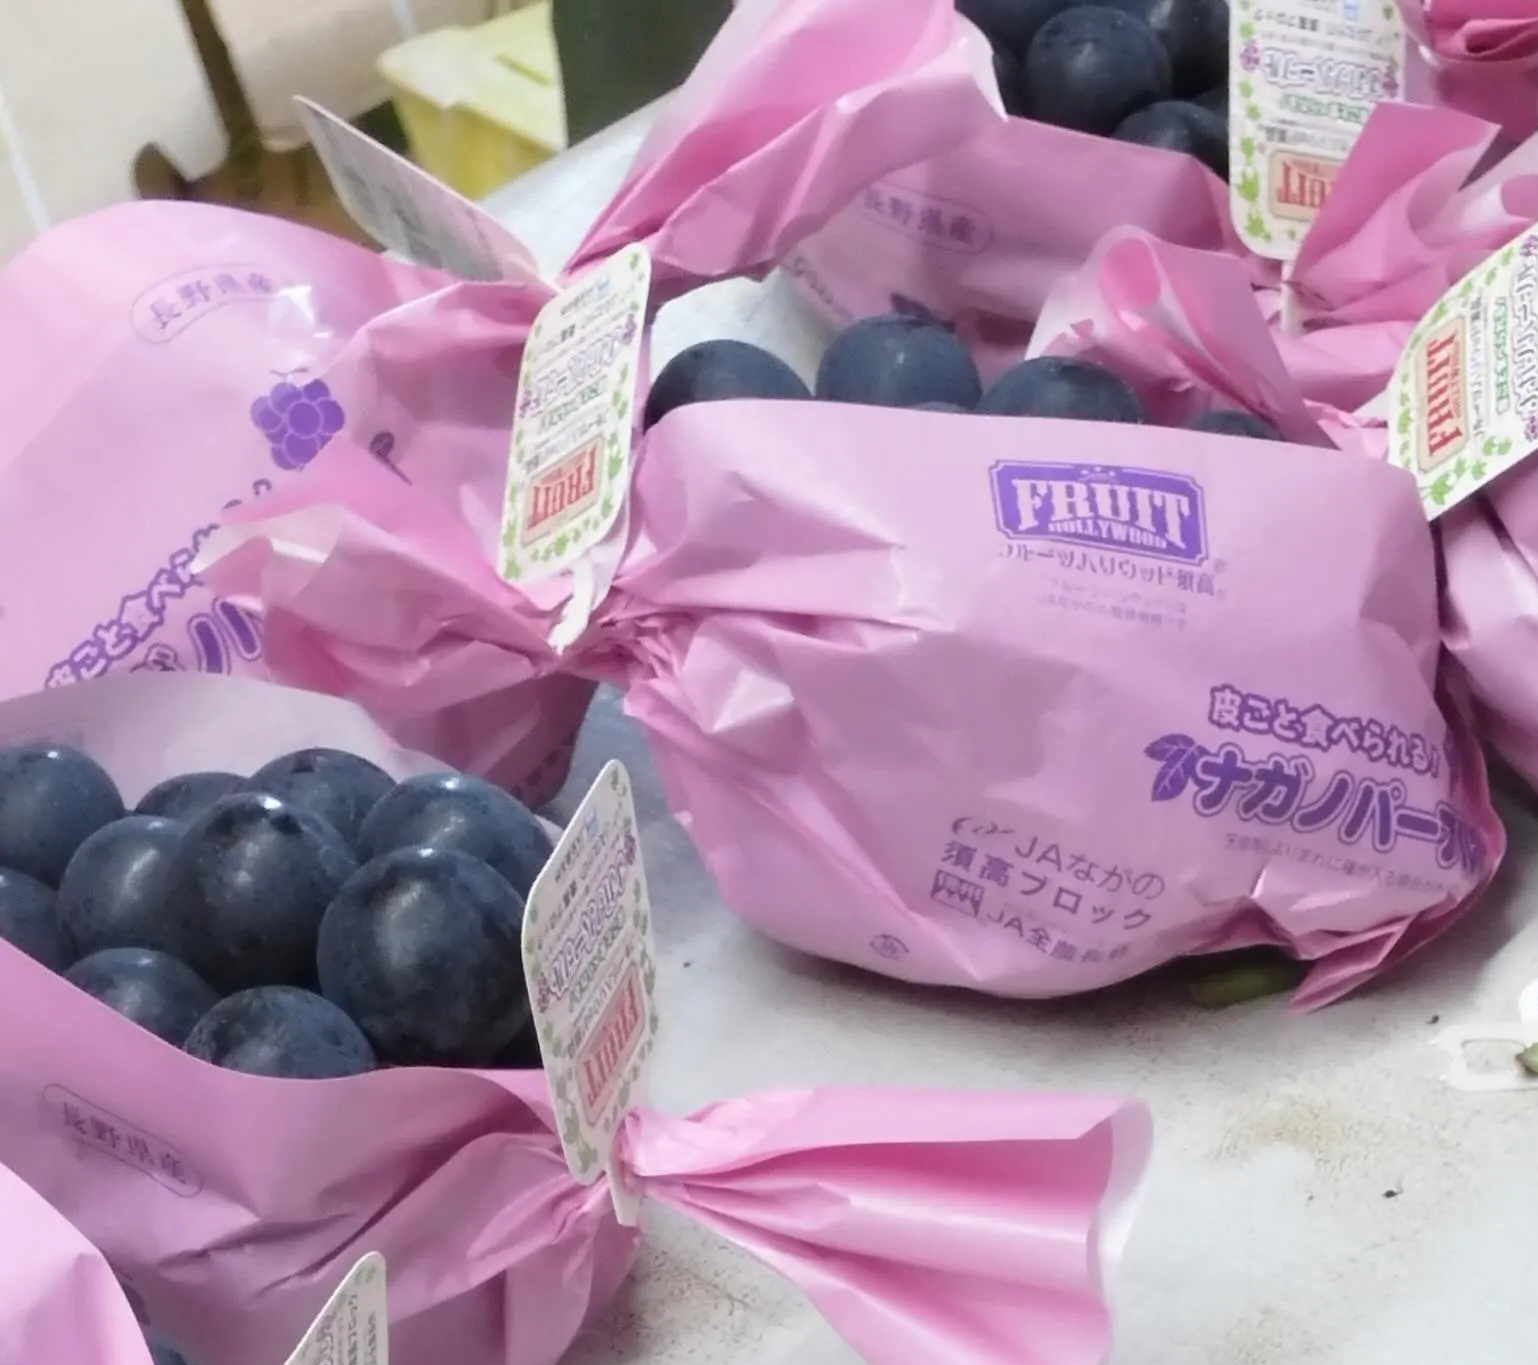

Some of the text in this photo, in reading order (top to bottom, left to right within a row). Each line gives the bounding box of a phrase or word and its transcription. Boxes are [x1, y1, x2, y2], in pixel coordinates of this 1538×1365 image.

[1277, 160, 1328, 209] UIT
[1427, 329, 1463, 457] FRUIT
[526, 446, 597, 532] FRUIT
[1010, 478, 1191, 550] FRUIT
[1048, 516, 1168, 549] HOLLYWOOD
[941, 840, 1152, 931] 須高ブロック
[1015, 836, 1166, 901] JAながの
